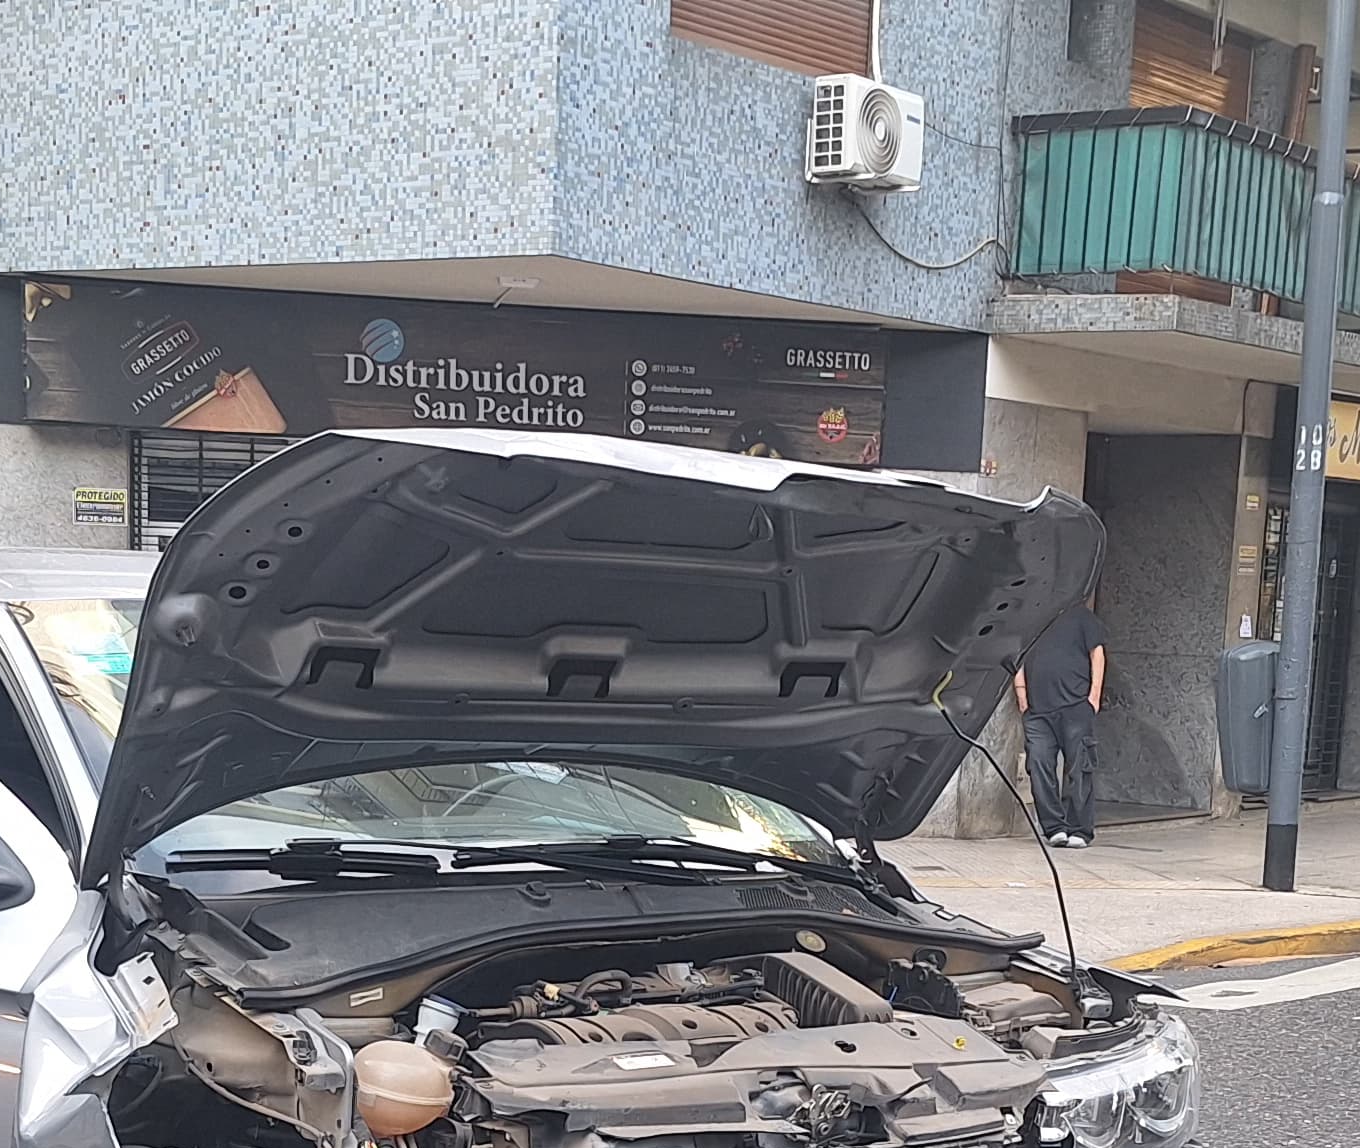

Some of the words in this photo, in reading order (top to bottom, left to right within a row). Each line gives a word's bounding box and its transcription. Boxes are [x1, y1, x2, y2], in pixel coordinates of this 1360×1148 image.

[130, 329, 191, 375] GRASSETTO
[786, 348, 871, 370] GRASSETTO
[131, 379, 175, 416] JAMÓN
[174, 346, 222, 382] COCIDO
[343, 352, 587, 397] Distribuidora
[413, 392, 467, 421] San
[475, 396, 584, 427] Pedrito
[76, 490, 125, 501] PROTEGIDO
